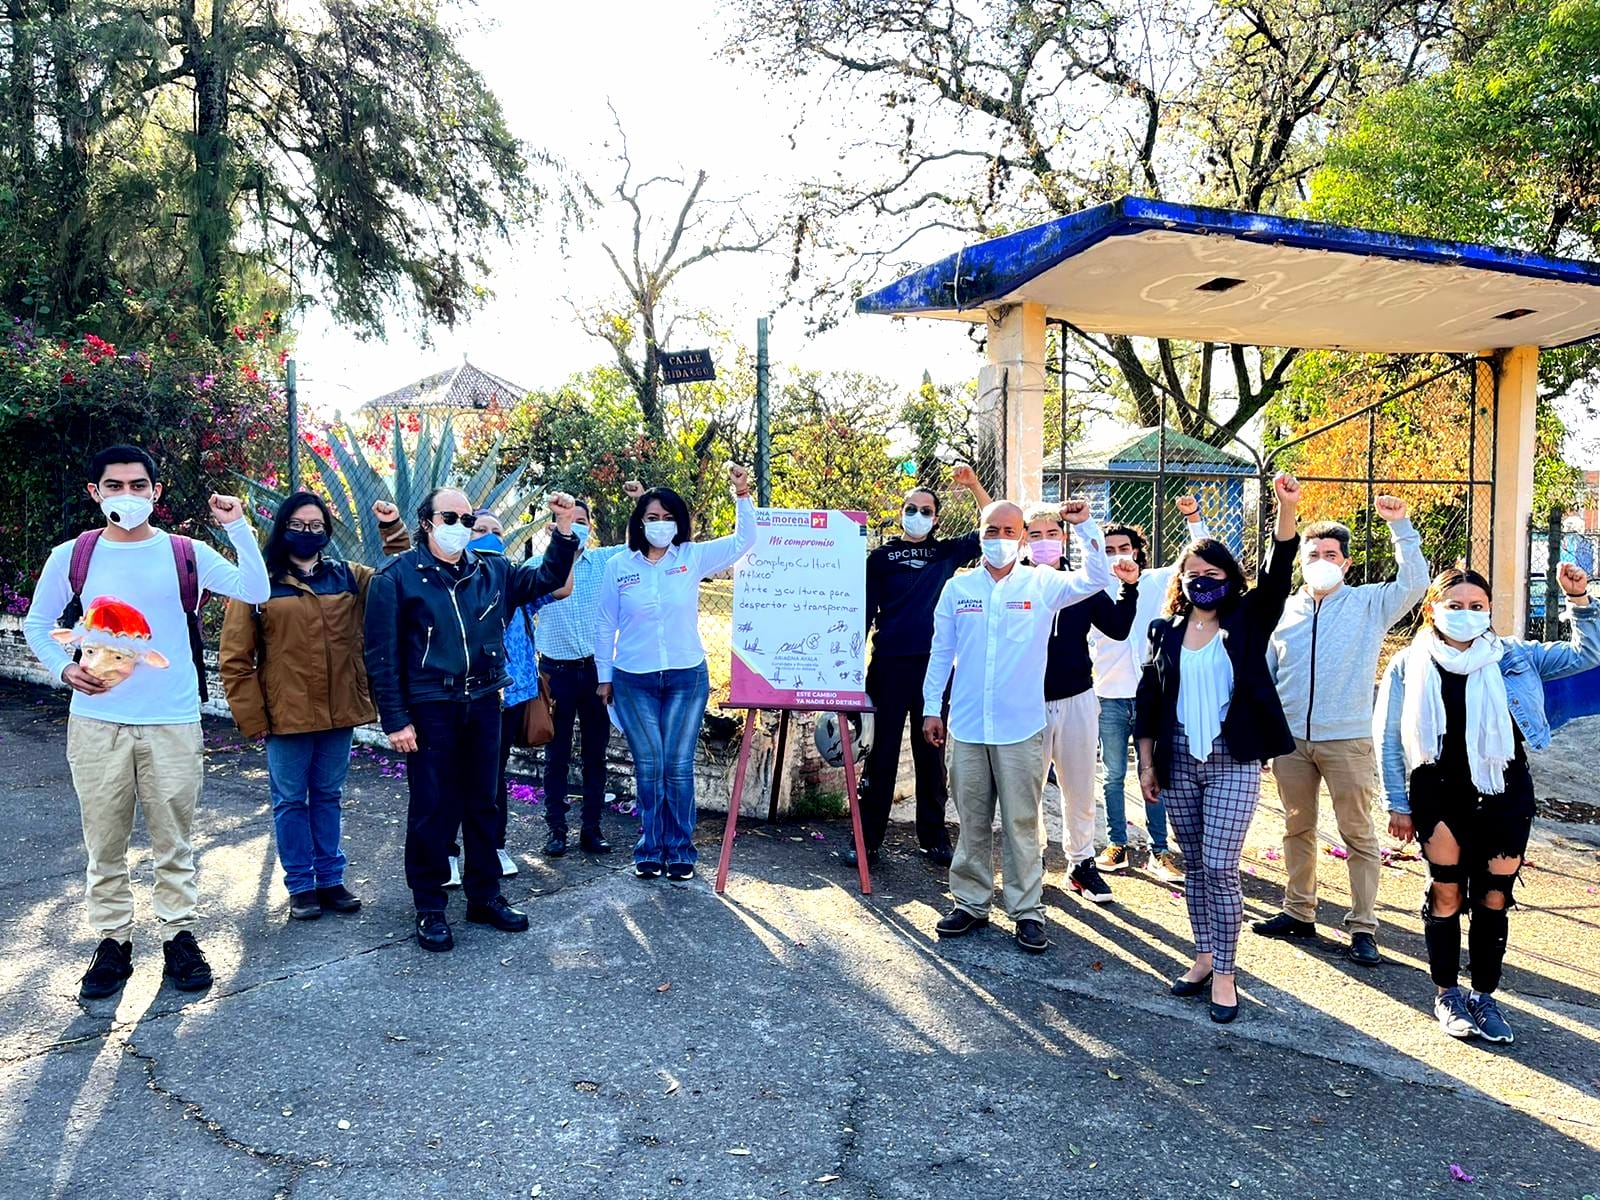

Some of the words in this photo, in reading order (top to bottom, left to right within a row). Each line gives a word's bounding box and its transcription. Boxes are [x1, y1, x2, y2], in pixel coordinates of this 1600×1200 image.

[669, 354, 702, 365] CALLE
[663, 368, 709, 379] HIDALGO
[772, 516, 810, 524] morena
[812, 517, 826, 527] PT
[769, 535, 782, 545] Mi
[784, 539, 835, 548] compromiso
[795, 558, 841, 569] Cultural
[744, 582, 768, 593] Arte
[829, 589, 851, 599] para
[793, 603, 801, 611] y
